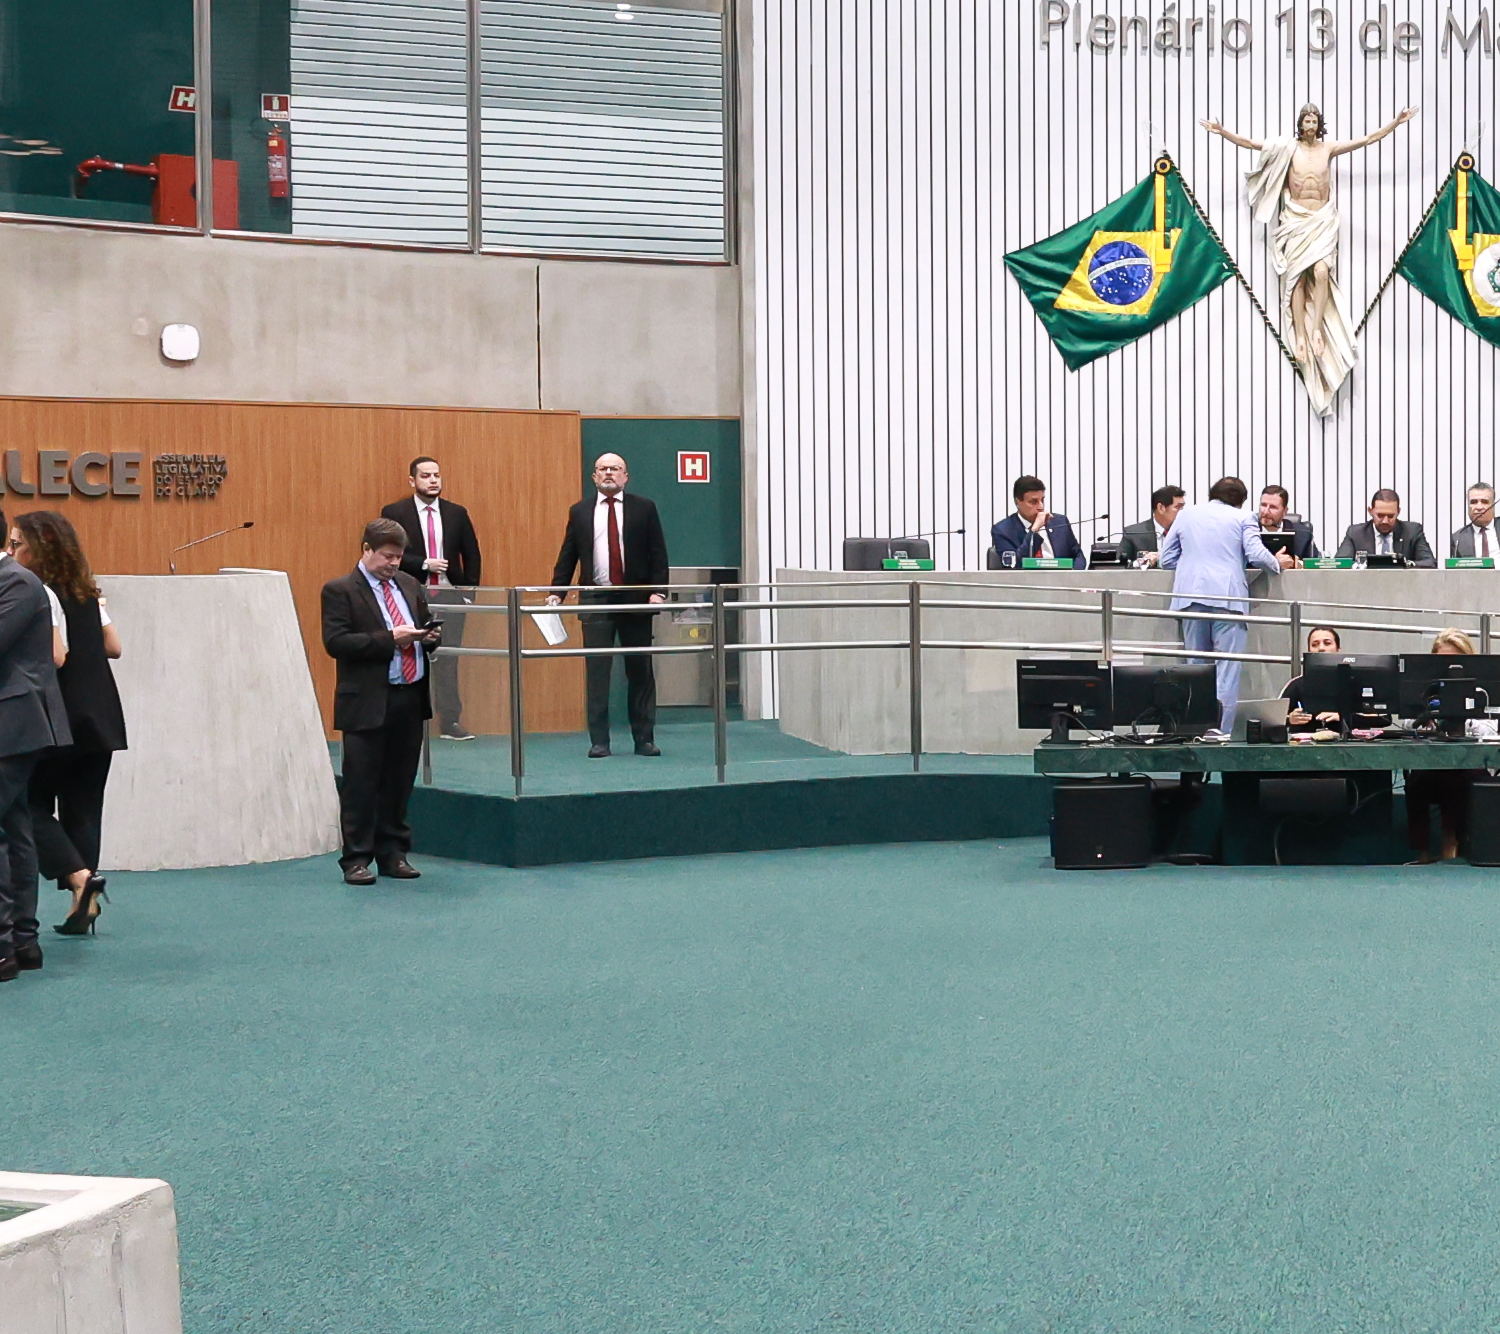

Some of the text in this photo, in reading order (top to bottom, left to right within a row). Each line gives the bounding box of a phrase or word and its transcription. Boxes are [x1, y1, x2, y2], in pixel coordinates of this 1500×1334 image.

[1274, 6, 1335, 54] 13
[1359, 4, 1421, 55] de
[176, 91, 196, 108] H
[685, 458, 702, 476] H
[156, 475, 172, 484] DO
